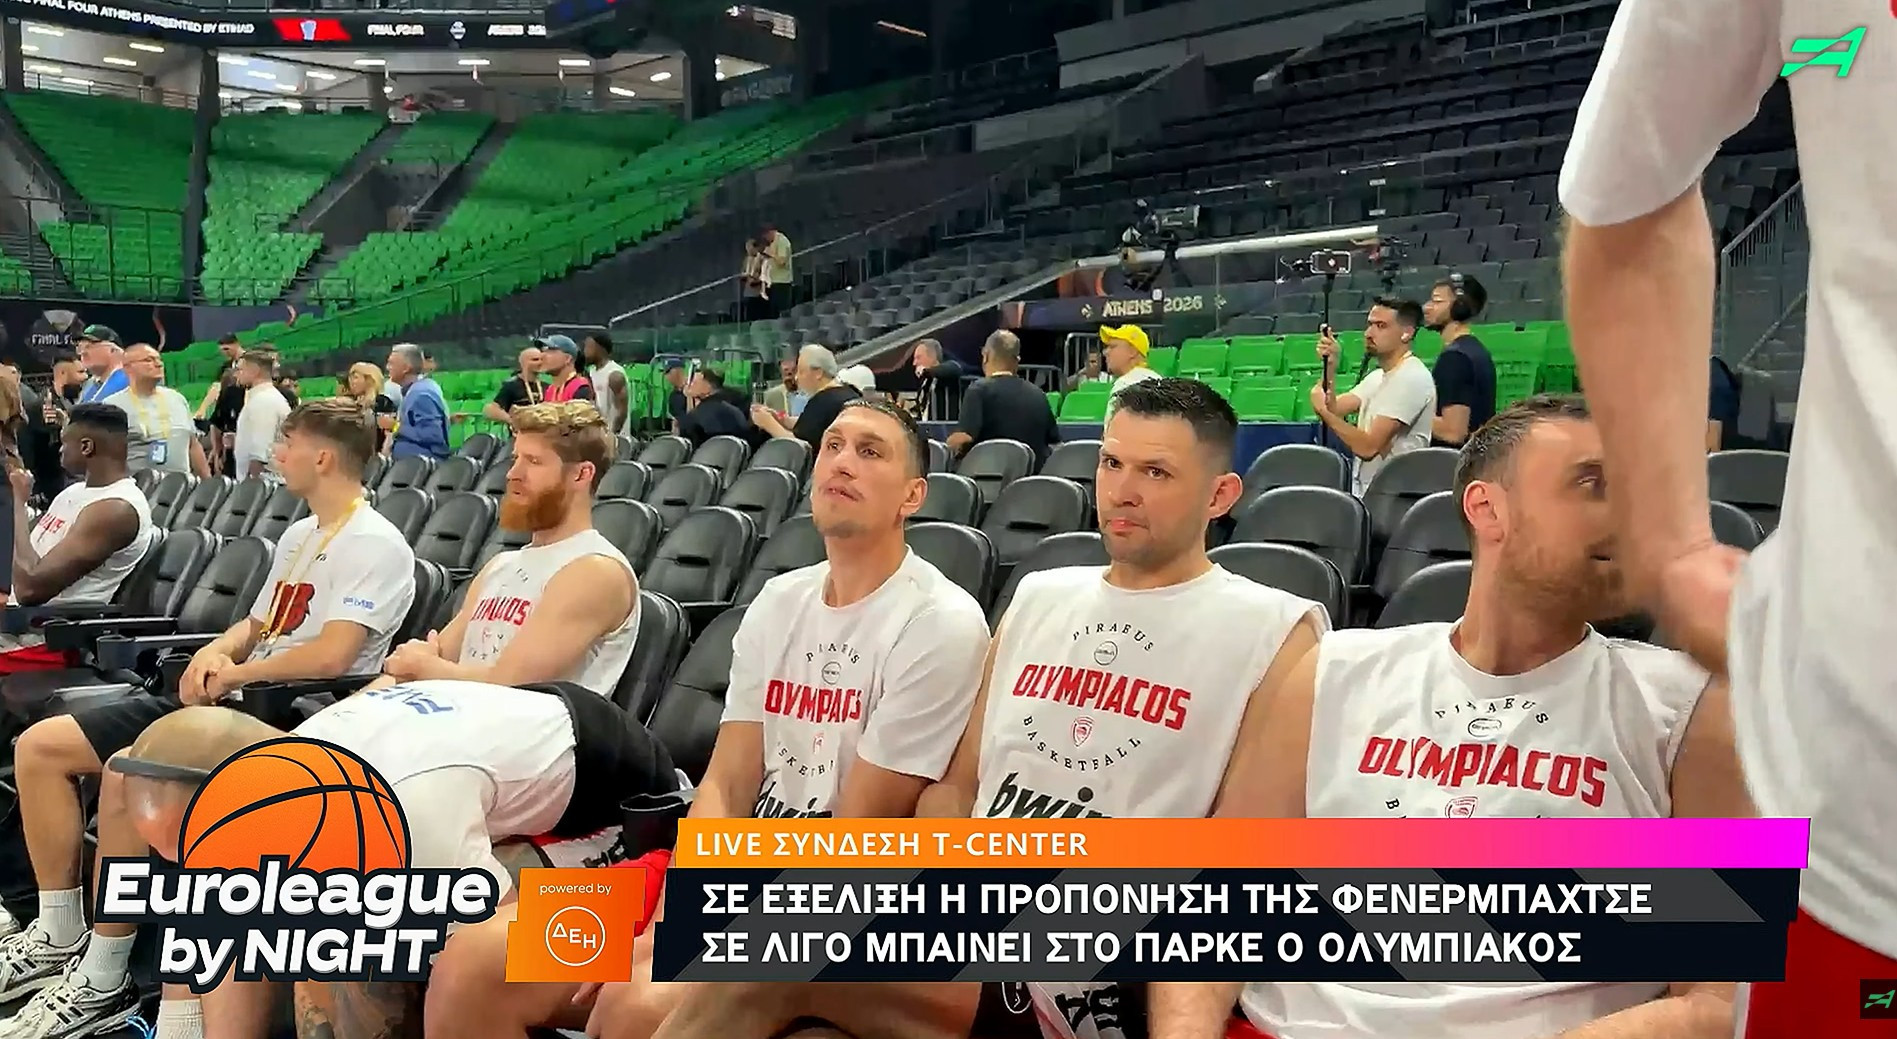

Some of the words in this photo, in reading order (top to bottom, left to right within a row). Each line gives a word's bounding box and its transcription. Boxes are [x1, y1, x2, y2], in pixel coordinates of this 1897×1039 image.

[67, 0, 99, 15] FOUR
[99, 6, 142, 23] ATHENS
[1103, 299, 1153, 317] ATHENS
[1163, 296, 1203, 313] 2026
[1072, 622, 1154, 652] PIRAEUS
[1012, 663, 1192, 731] OLYMPIACOS
[1023, 715, 1142, 771] BASKETBALL
[1358, 736, 1608, 807] OLYMPIACOS
